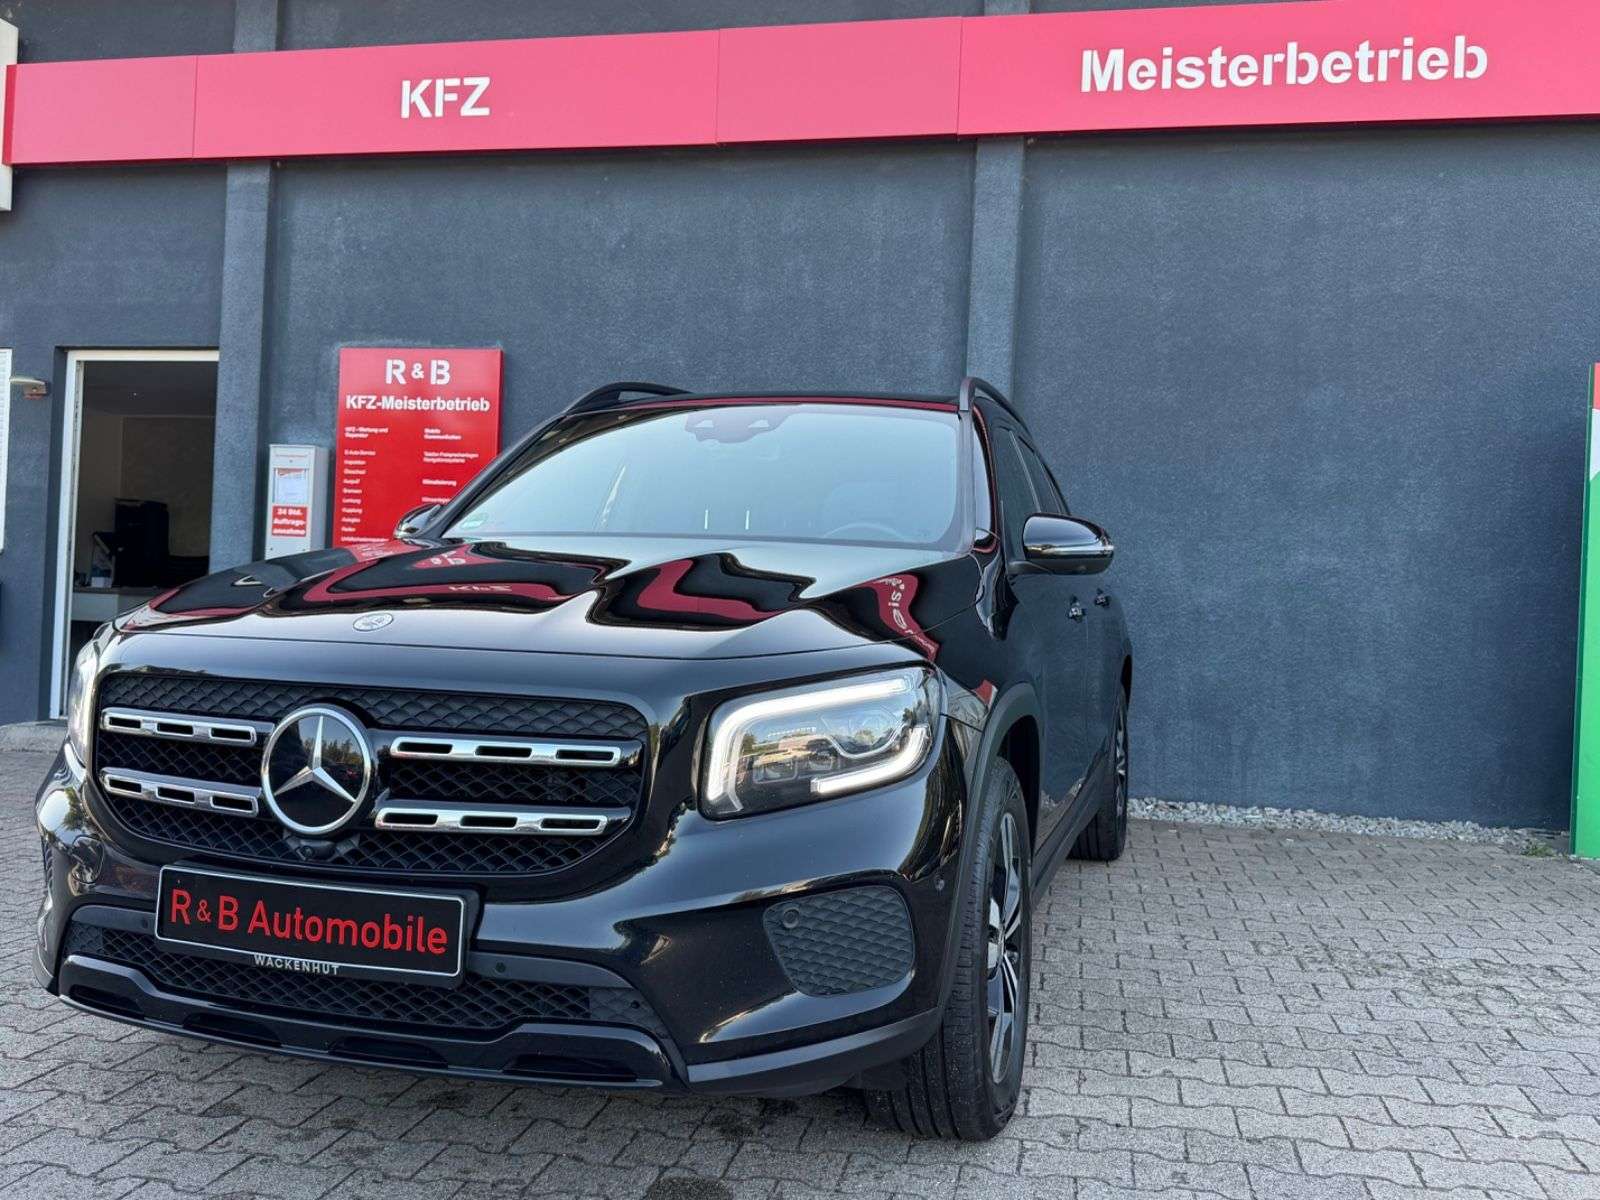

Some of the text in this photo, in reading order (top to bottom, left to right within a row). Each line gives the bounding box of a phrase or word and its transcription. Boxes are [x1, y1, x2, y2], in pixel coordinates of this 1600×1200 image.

[1080, 35, 1487, 92] Meisterbetrieb
[400, 76, 491, 119] KFZ
[385, 359, 450, 385] R & B
[345, 394, 490, 412] KFZ-Meisterbetrieb
[169, 888, 449, 955] R & B Automobile
[253, 953, 340, 976] WACKENHUT
